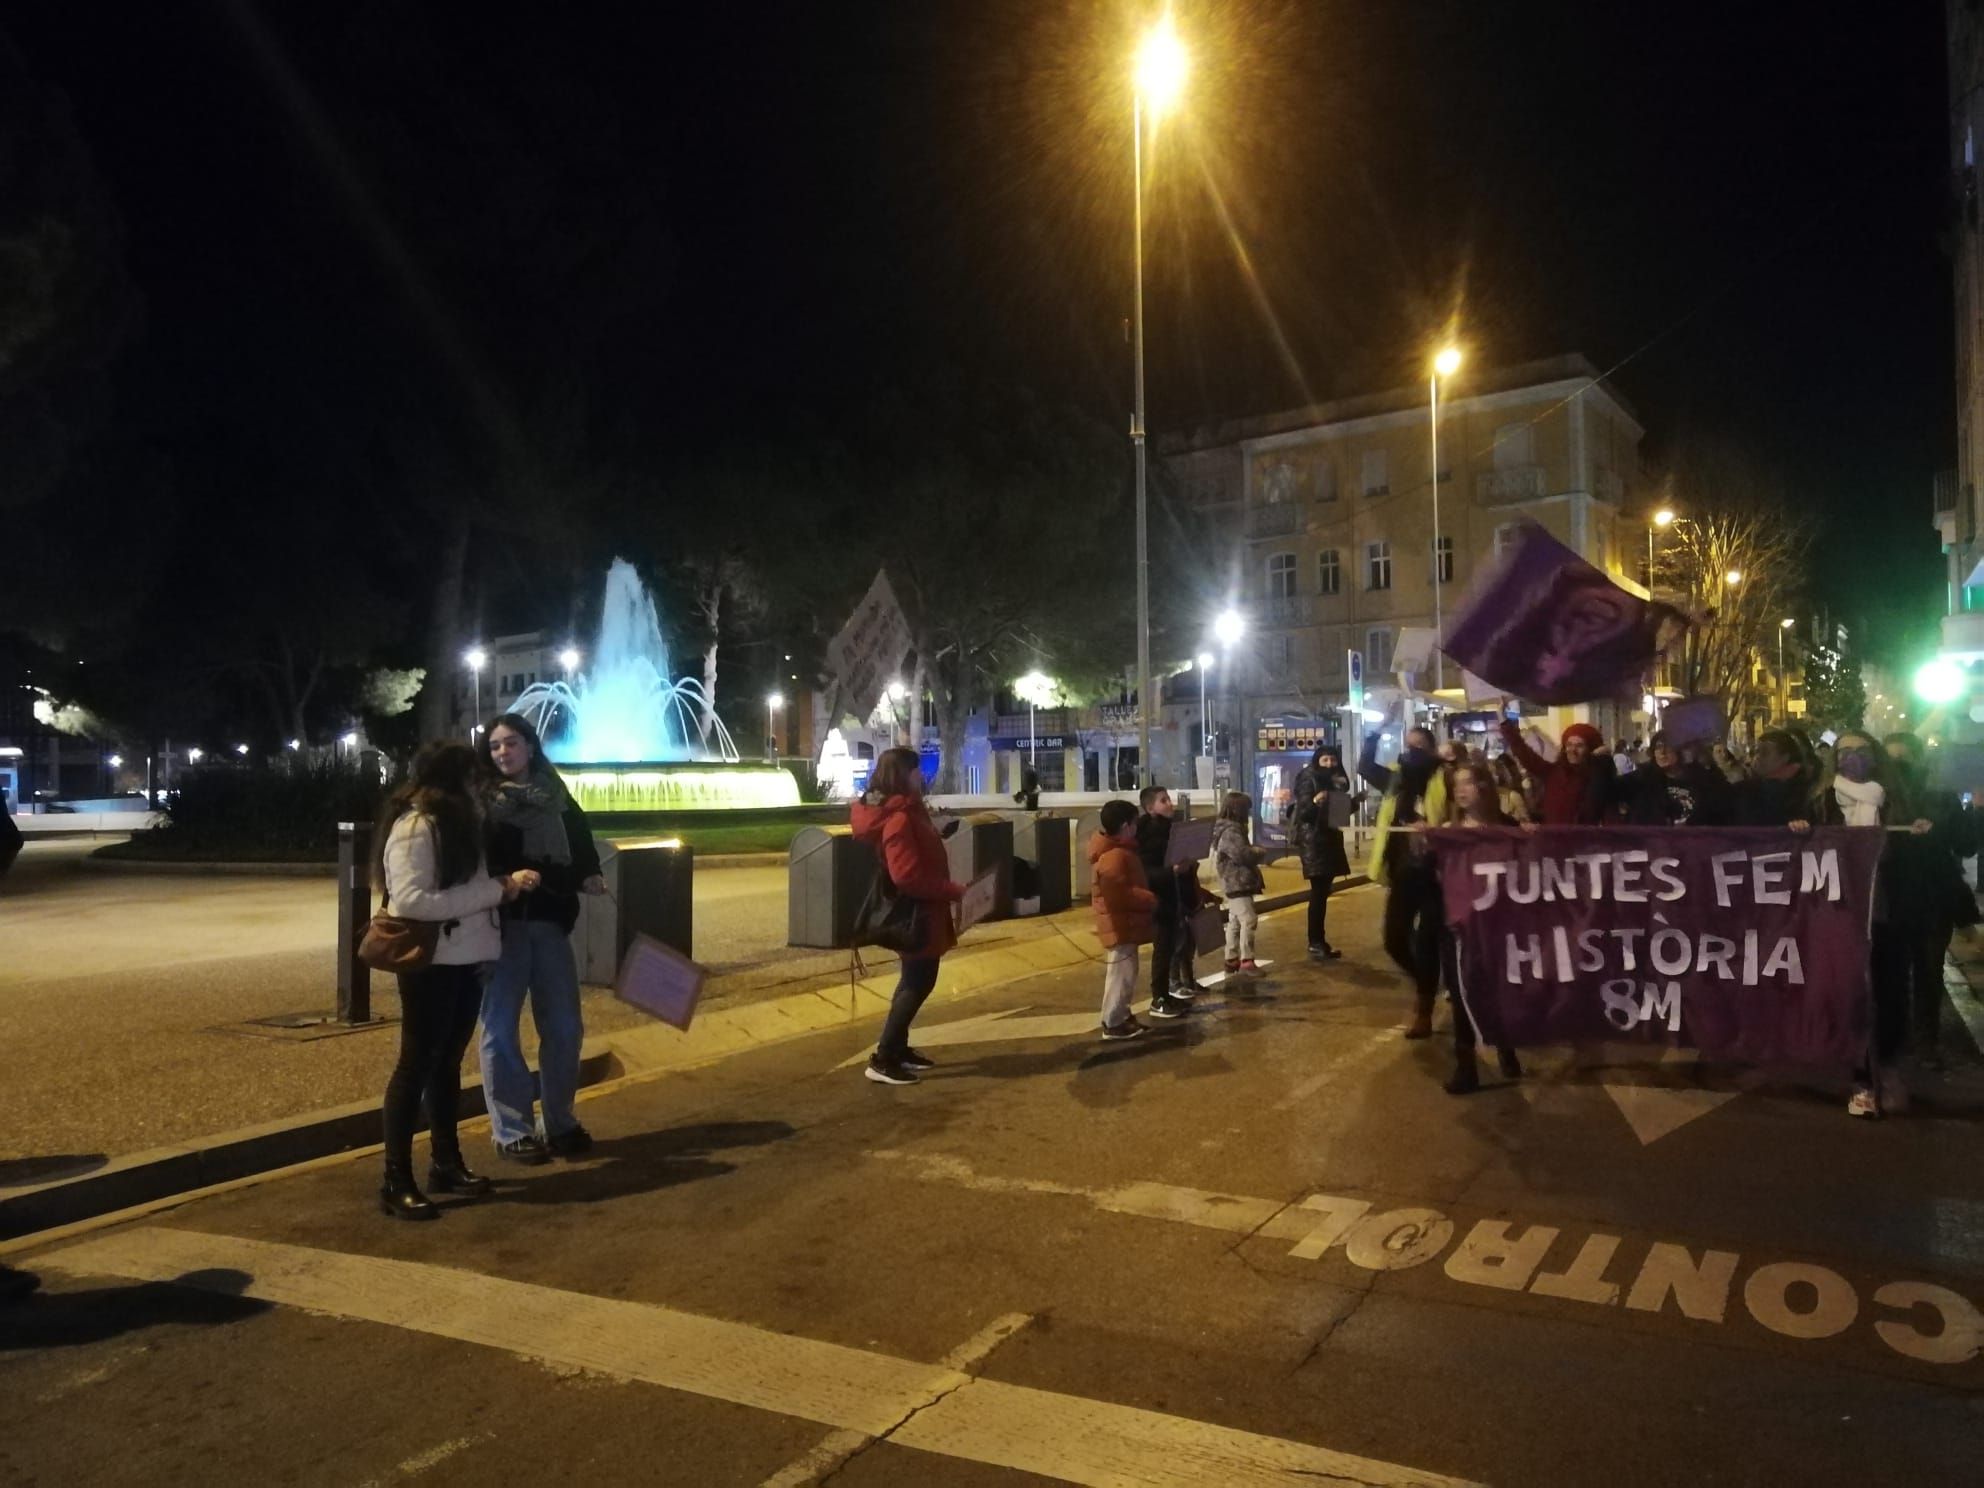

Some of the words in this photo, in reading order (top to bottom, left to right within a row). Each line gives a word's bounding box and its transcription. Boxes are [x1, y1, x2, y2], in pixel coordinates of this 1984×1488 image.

[1472, 849, 1687, 912] JUNTES
[1711, 848, 1842, 908] FEM
[1505, 912, 1805, 987] HISTÒRIA
[1600, 978, 1682, 1033] 8M
[1288, 1193, 1984, 1365] CONTROL
